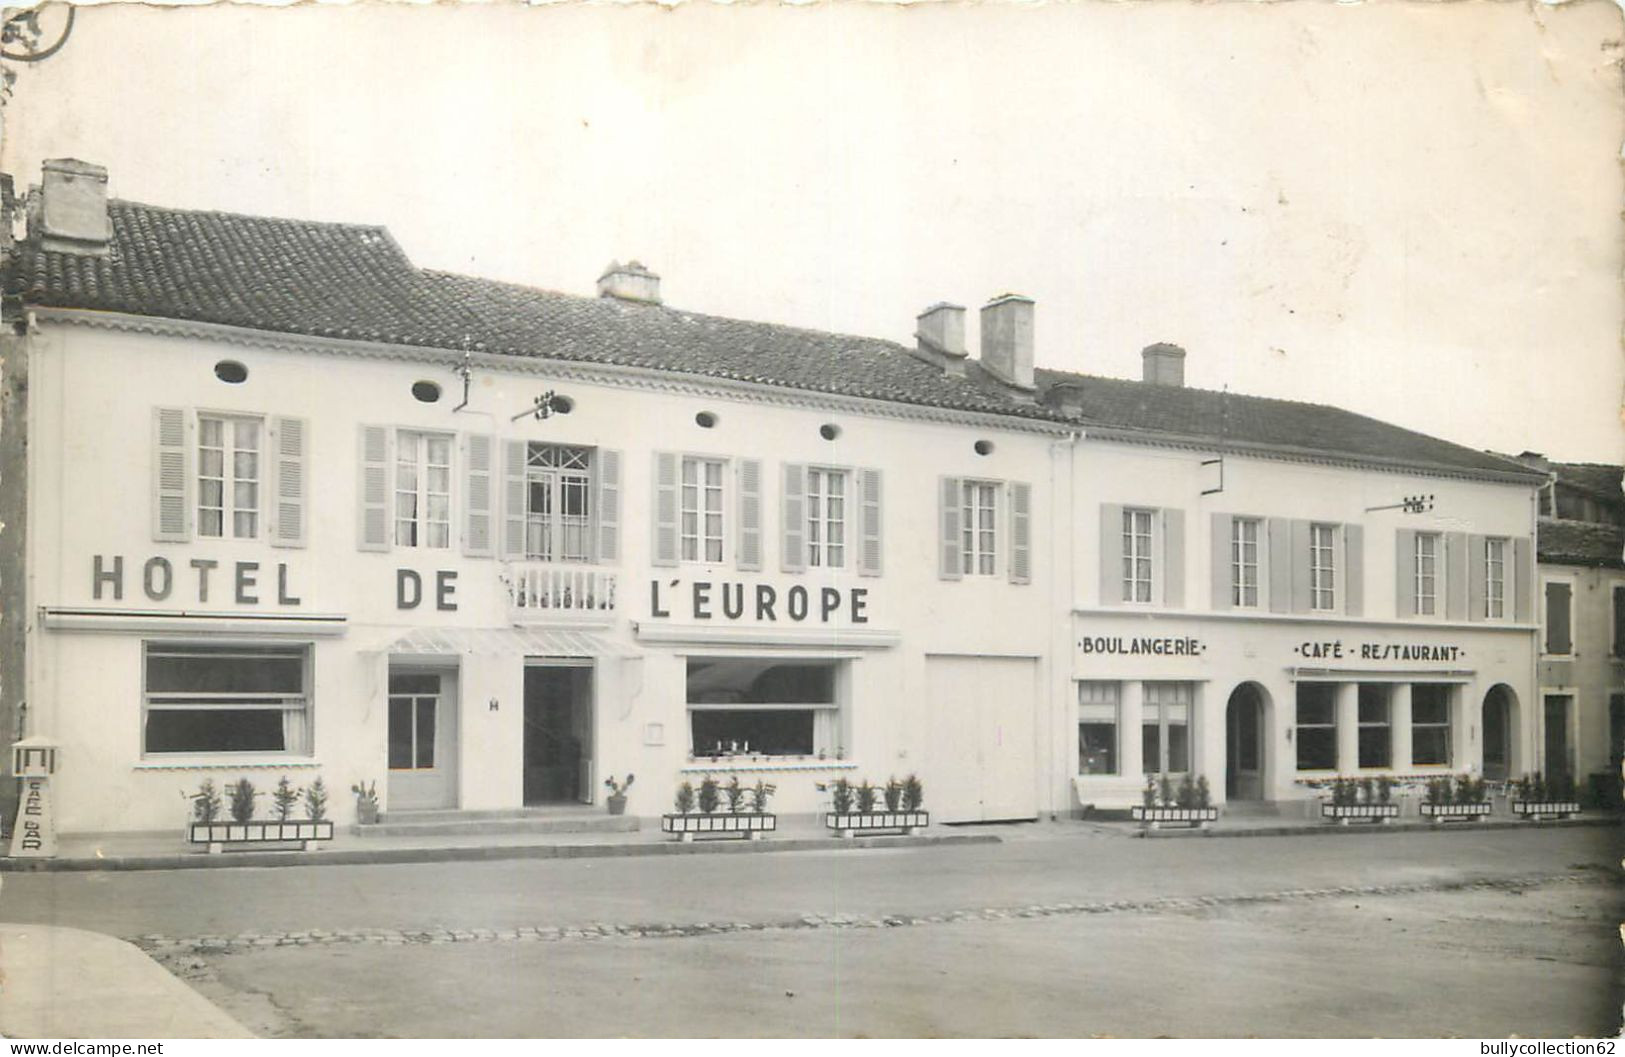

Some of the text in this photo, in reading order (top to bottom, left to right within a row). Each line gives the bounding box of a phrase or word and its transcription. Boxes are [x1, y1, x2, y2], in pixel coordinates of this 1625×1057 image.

[92, 554, 869, 624] HOTEL DE L'EUROPE
[1082, 637, 1201, 656] BOULANGERIE
[1301, 640, 1460, 662] CAFÉ RESTAURANT
